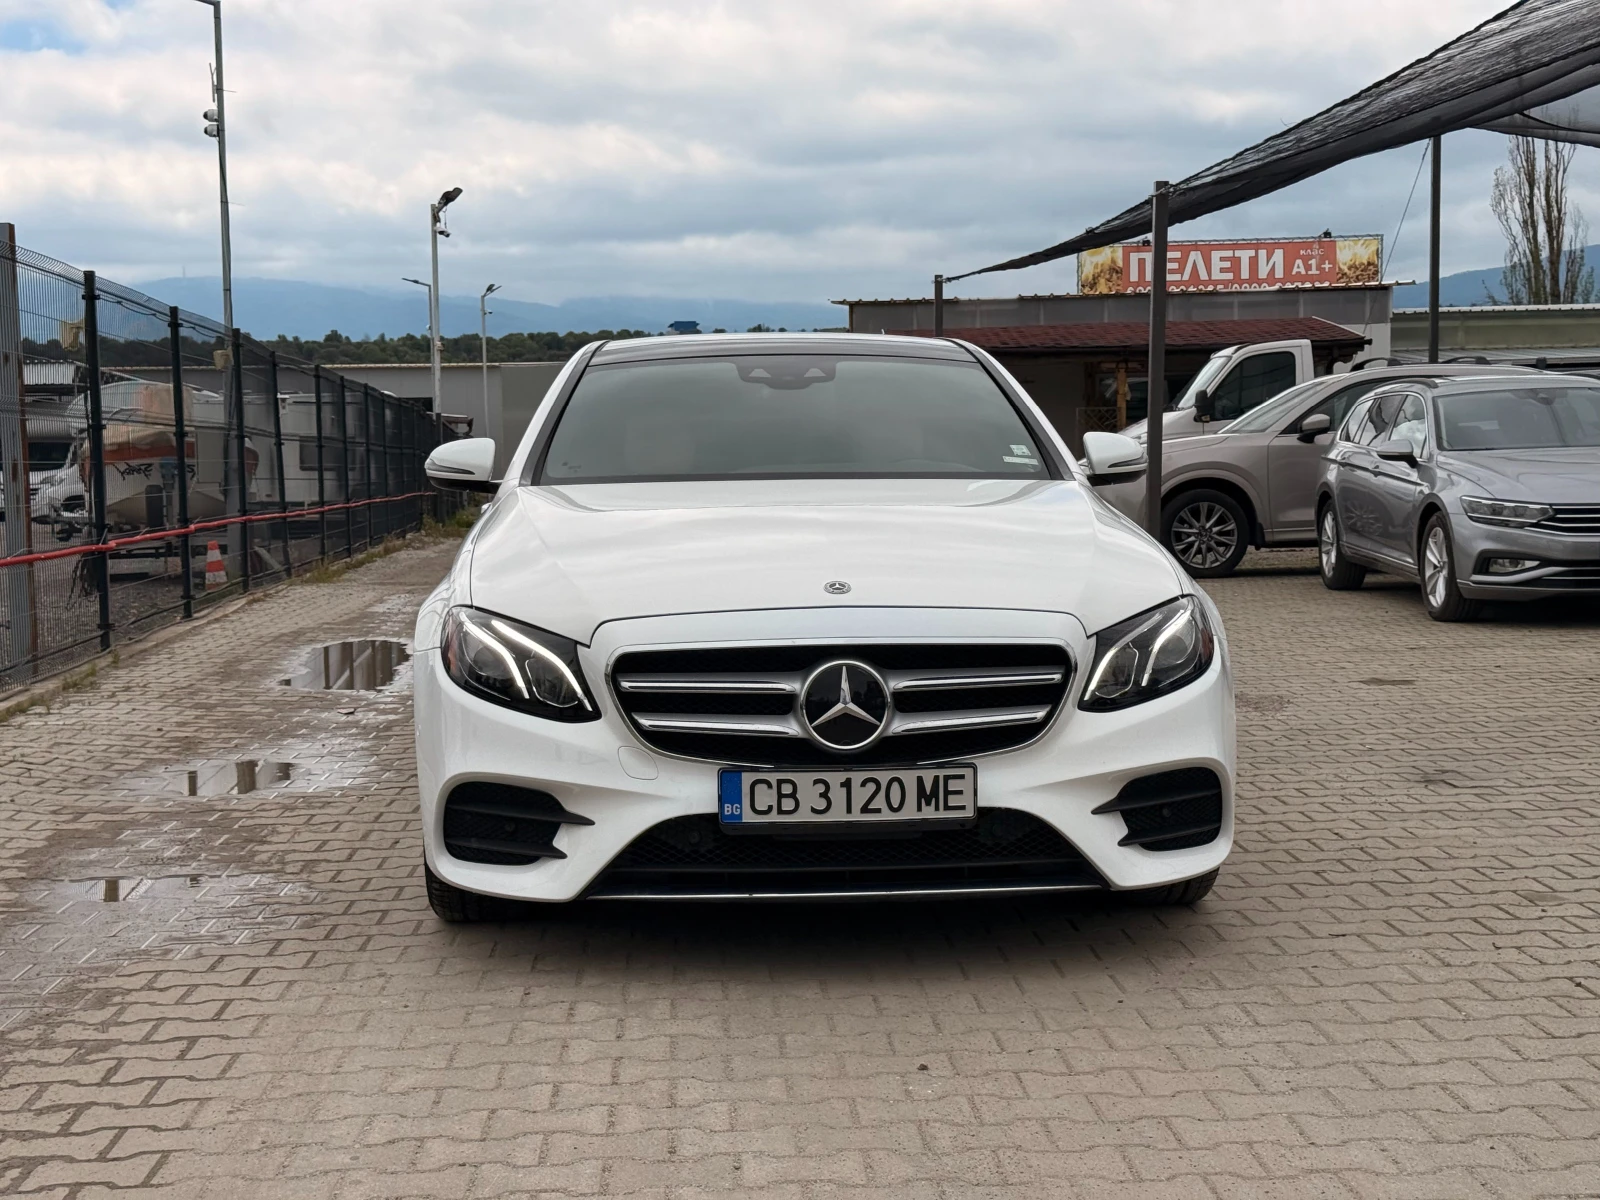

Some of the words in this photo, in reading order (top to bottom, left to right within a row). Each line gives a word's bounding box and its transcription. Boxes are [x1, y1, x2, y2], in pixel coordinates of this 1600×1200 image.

[1300, 248, 1325, 256] клас
[1129, 248, 1284, 282] ПЕЛЕТИ
[749, 778, 801, 815] CB
[810, 776, 907, 815] 3120
[916, 773, 967, 813] ME
[724, 803, 741, 815] BG
